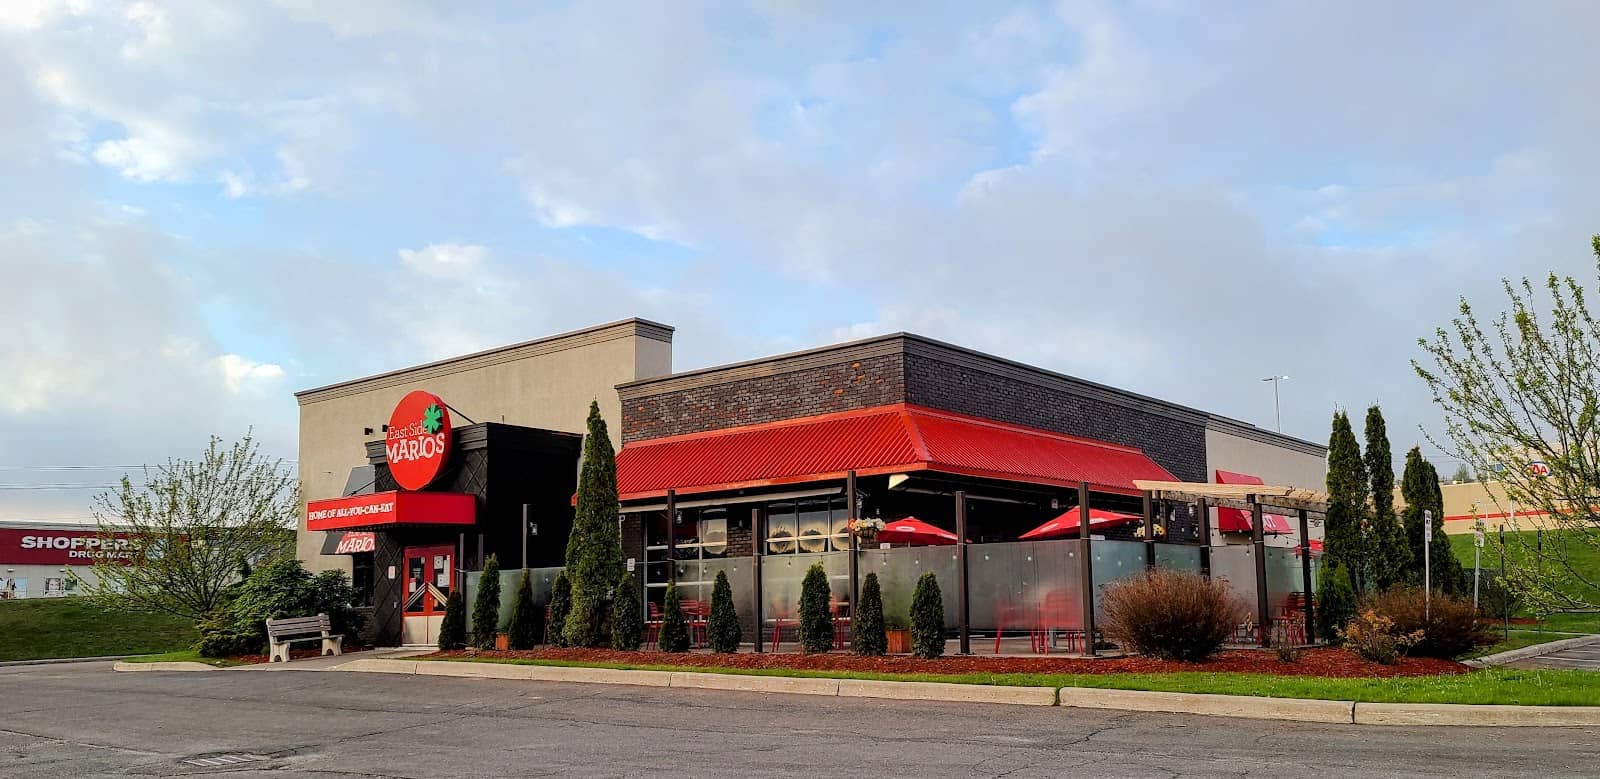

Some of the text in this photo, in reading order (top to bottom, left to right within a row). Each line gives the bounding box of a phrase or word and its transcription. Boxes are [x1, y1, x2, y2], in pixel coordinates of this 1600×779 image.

[388, 420, 428, 440] East Side
[308, 503, 394, 521] HOME OF ALL-YOU-CAN-EAT
[335, 537, 375, 554] MARIO
[69, 550, 105, 559] DRUG
